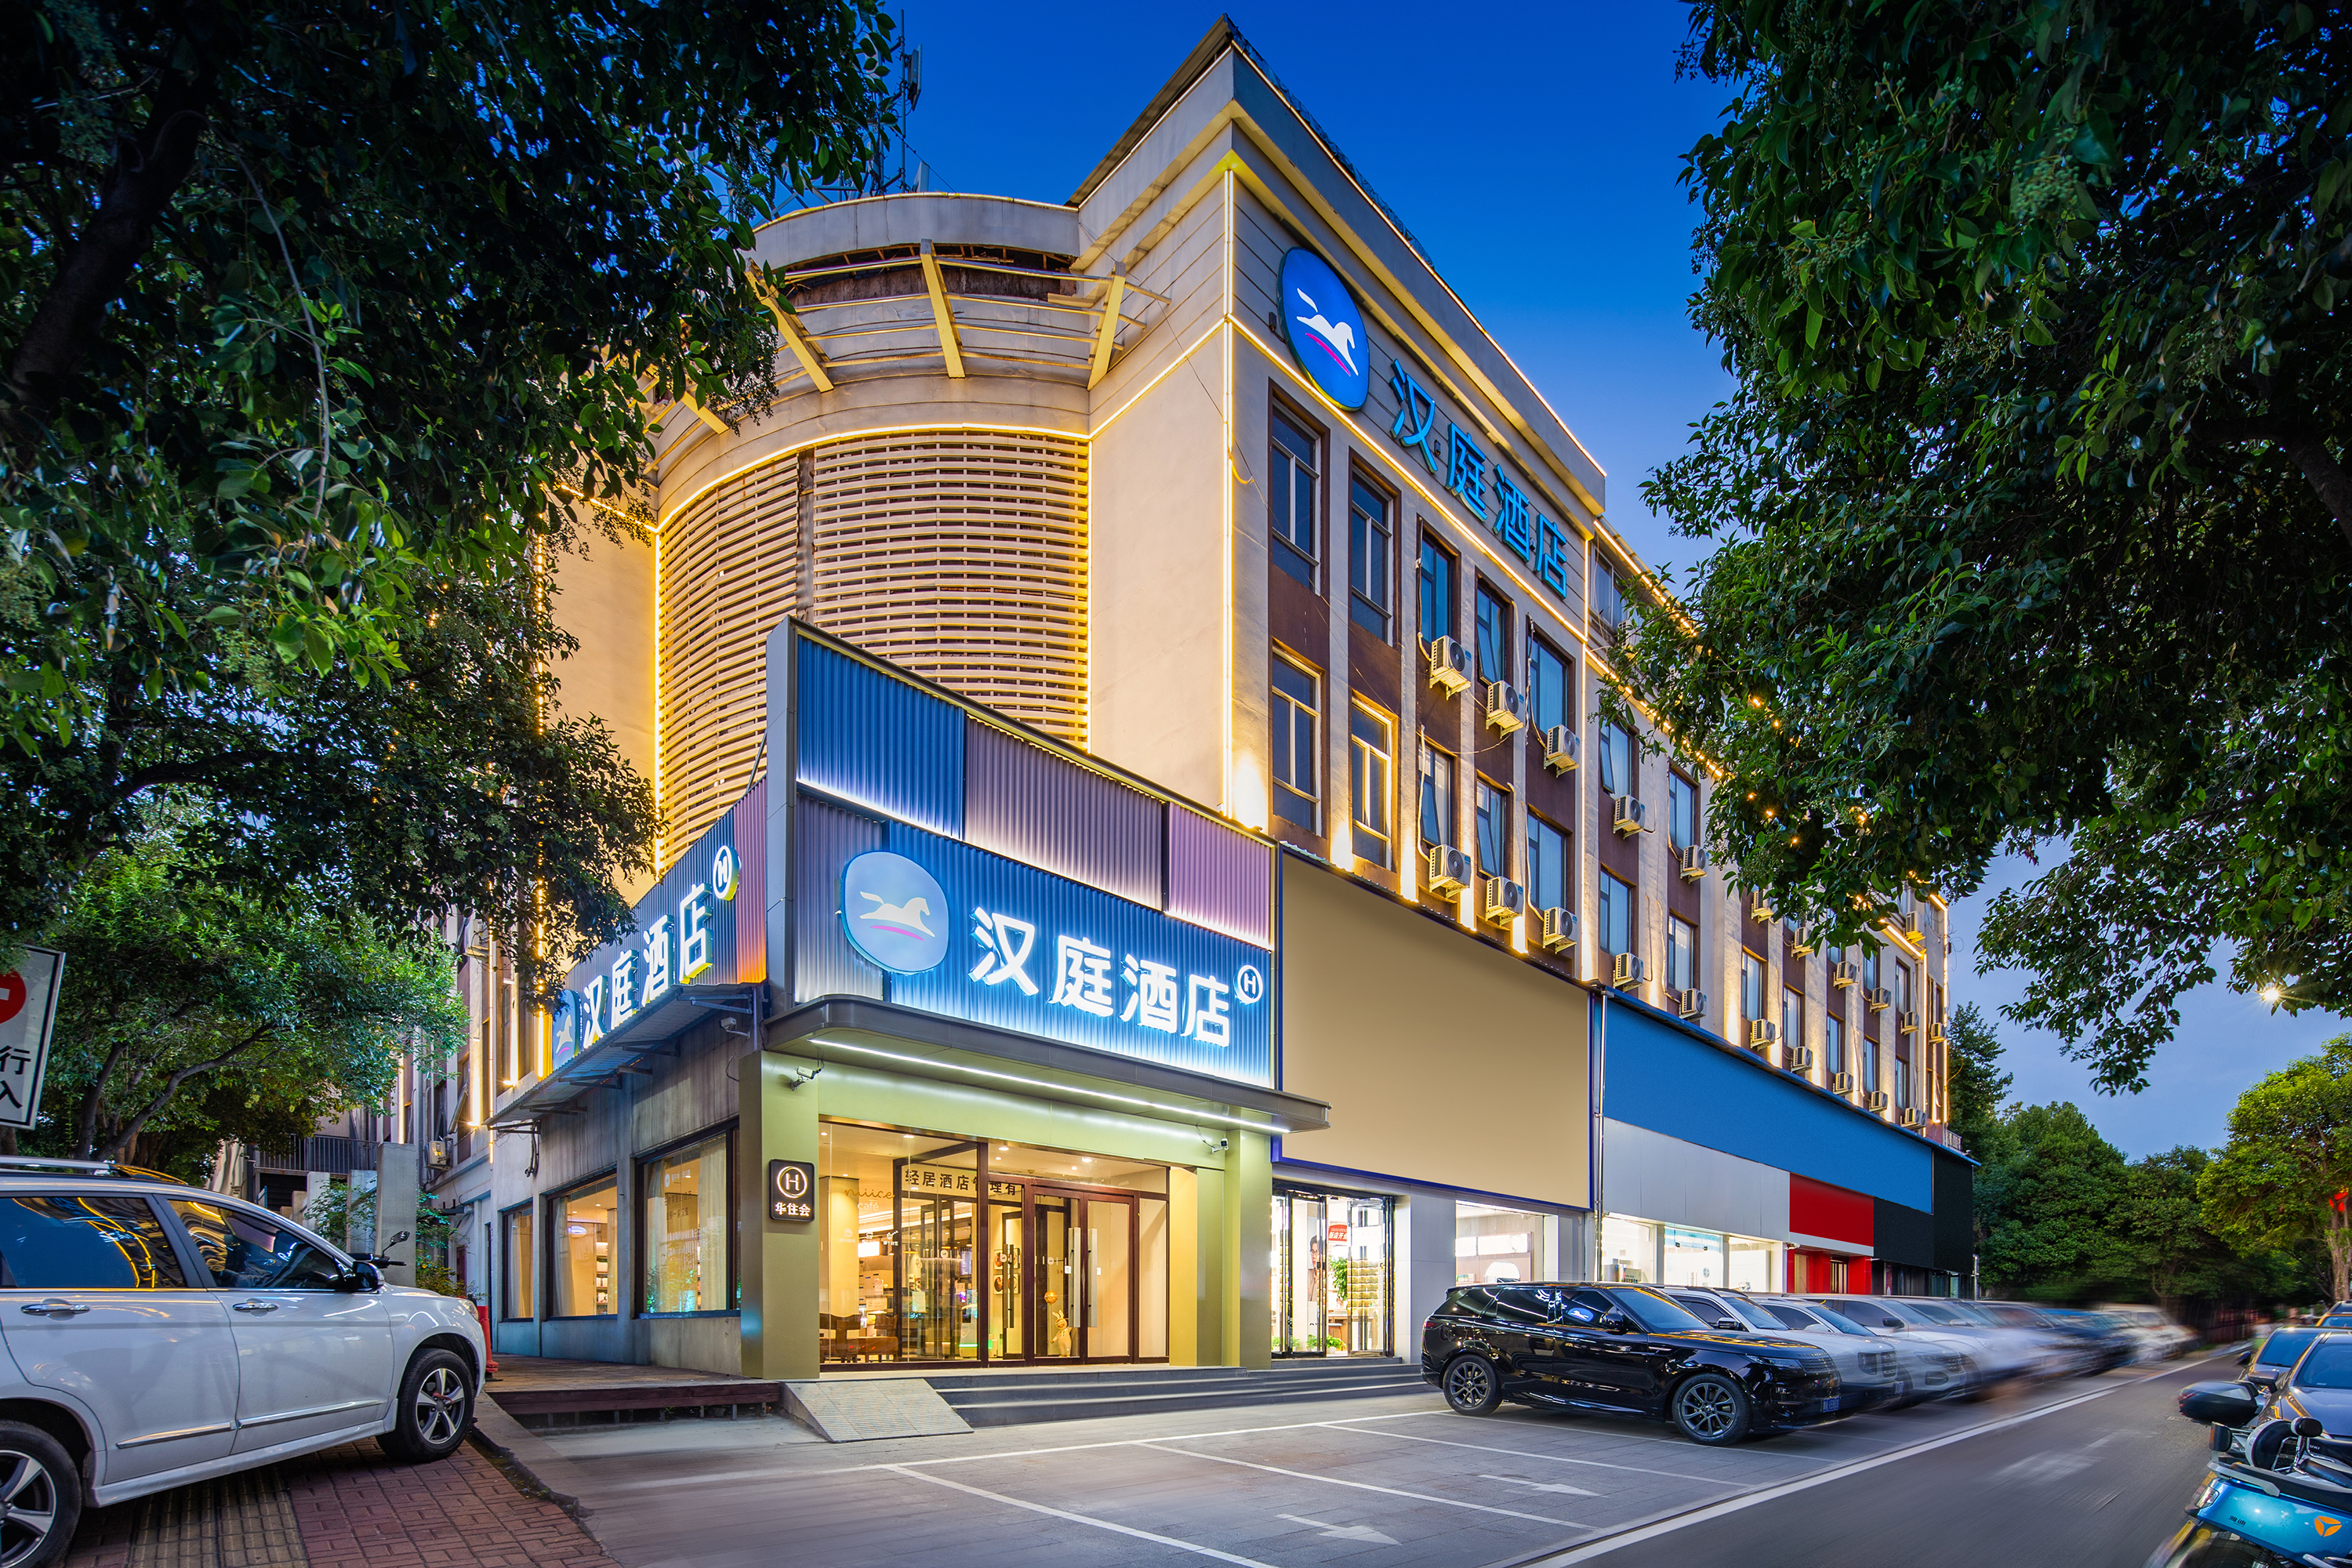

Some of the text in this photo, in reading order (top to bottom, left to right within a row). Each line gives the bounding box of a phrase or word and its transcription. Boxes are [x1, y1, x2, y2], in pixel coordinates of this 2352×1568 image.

[1389, 358, 1566, 600] 汉庭酒店
[583, 883, 710, 1049] 汉庭酒店
[969, 907, 1229, 1047] 汉庭酒店
[775, 1202, 811, 1217] 华住会
[858, 1201, 879, 1211] café
